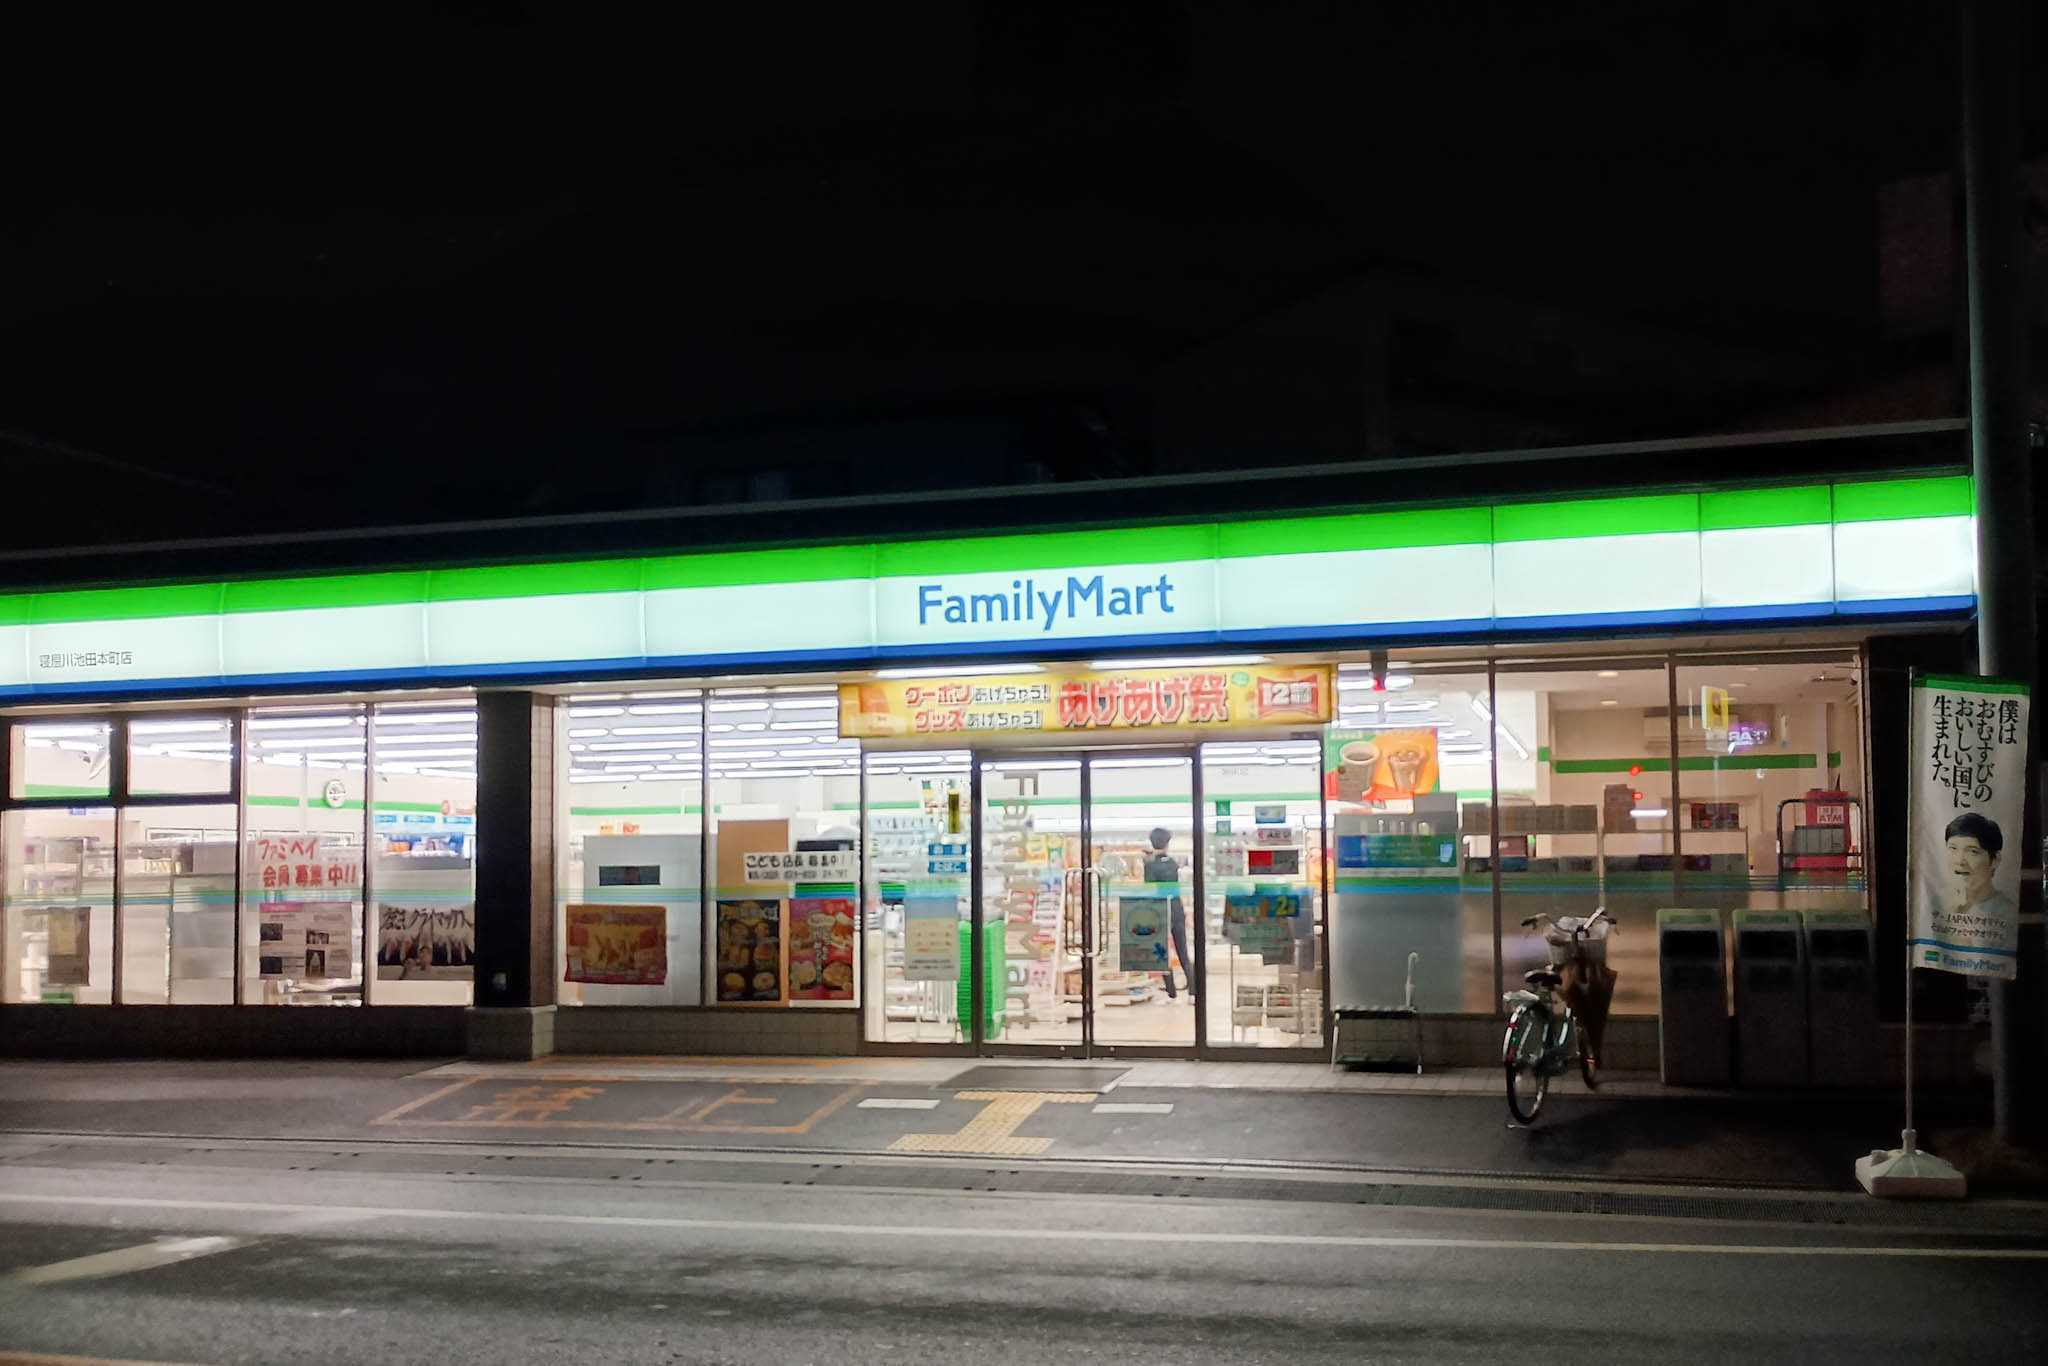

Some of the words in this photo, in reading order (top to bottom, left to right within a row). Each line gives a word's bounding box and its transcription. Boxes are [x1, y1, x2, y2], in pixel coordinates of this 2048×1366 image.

[919, 574, 1174, 632] FamilyMart
[1931, 695, 1953, 787] 生まれた。
[1952, 696, 1974, 808] おいしい国に
[1974, 698, 1996, 803] おむすびの
[1998, 699, 2019, 745] 僕は
